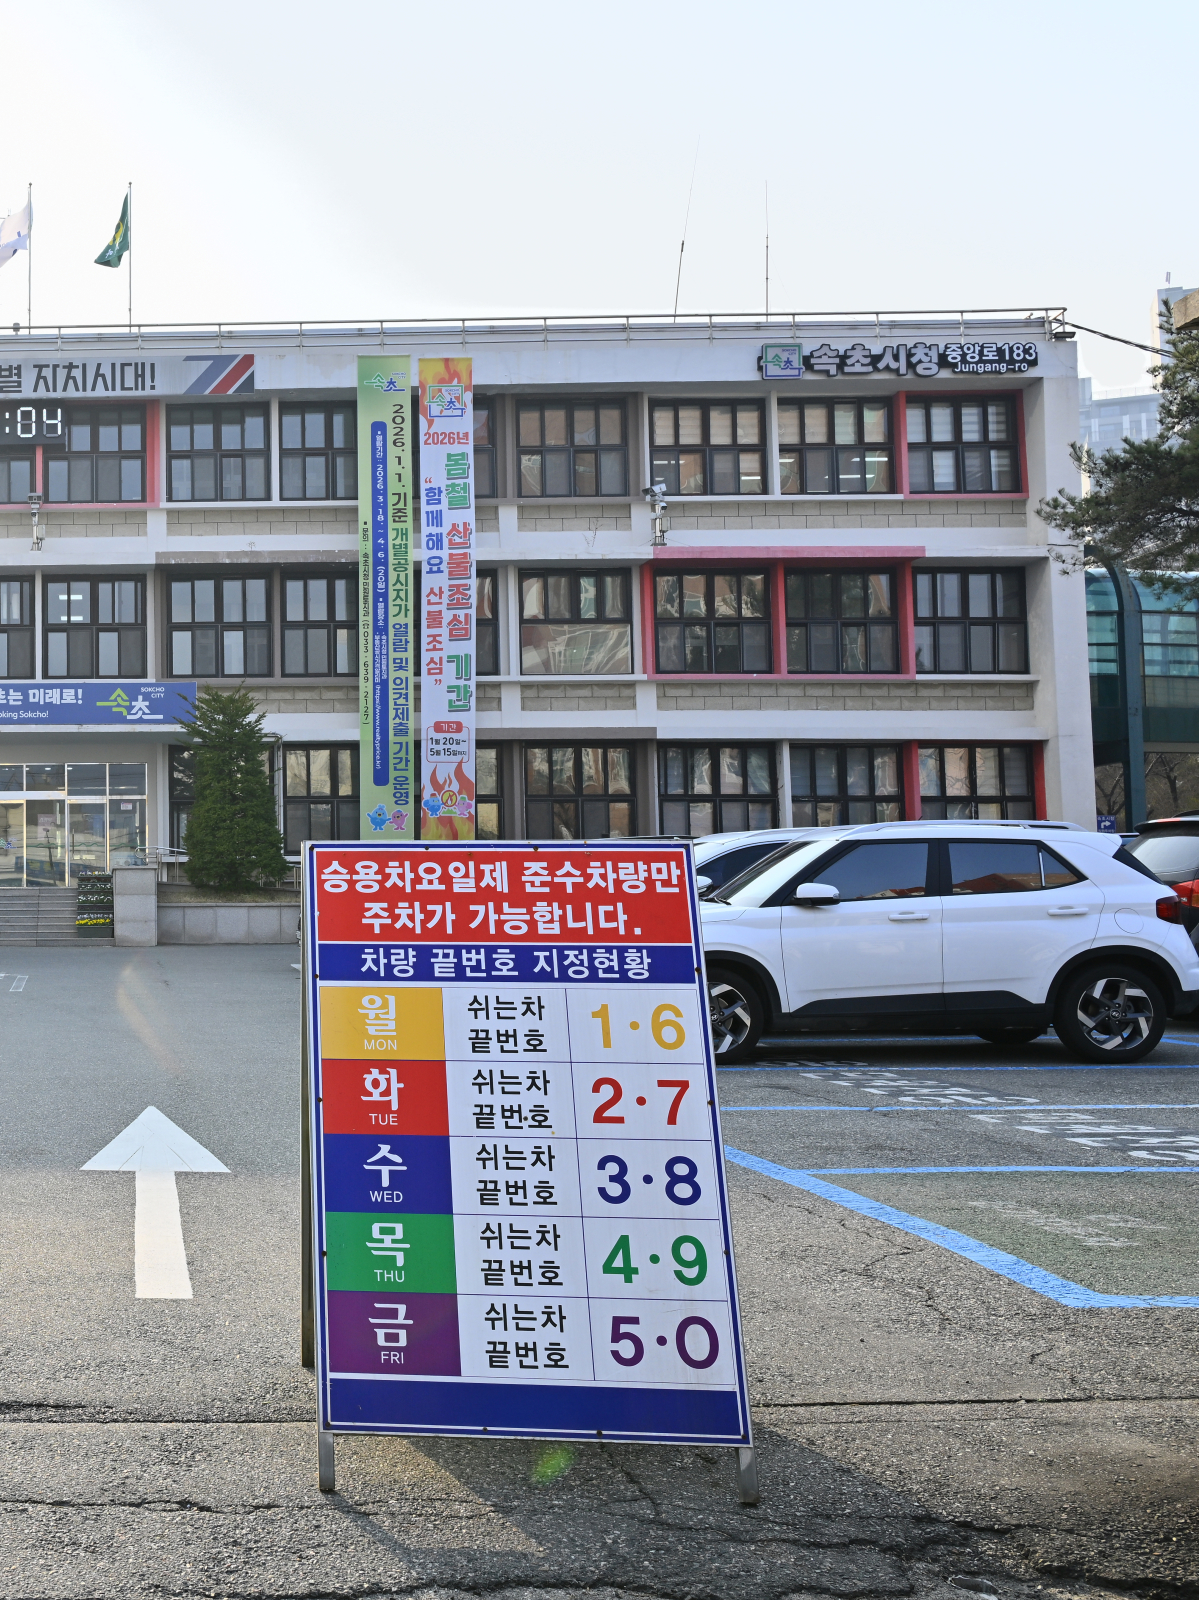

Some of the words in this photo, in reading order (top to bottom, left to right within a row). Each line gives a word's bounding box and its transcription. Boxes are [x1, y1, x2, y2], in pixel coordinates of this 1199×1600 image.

[810, 343, 941, 377] 속초시청
[945, 343, 1037, 362] 중앙로183
[955, 361, 1029, 373] Jungang-ro
[32, 362, 157, 394] 자치시대!
[424, 432, 469, 445] 2026년
[445, 452, 471, 510] 봄철
[392, 492, 408, 523] 기준
[392, 528, 410, 618] 개별공시지가
[446, 522, 472, 640] 산불조심
[392, 622, 410, 653] 열람
[393, 657, 408, 672] 및
[29, 688, 83, 706] 미래로!
[447, 653, 472, 712] 기간
[19, 710, 50, 720] Sokcho!
[392, 677, 410, 737] 의견제출
[440, 723, 457, 732] 기간
[393, 741, 410, 772] 기간
[430, 748, 441, 756] 5월
[393, 775, 410, 806] 운영
[321, 860, 509, 894] 승용차요일제
[521, 860, 681, 894] 준수차량만
[361, 902, 456, 935] 주차가
[469, 901, 642, 936] 가능합니다.
[361, 948, 417, 977] 차량
[430, 948, 519, 978] 끝번호
[533, 949, 652, 980] 지정현황
[358, 994, 397, 1036] 월
[468, 994, 545, 1021] 쉬는차
[364, 1040, 398, 1051] MON
[468, 1029, 548, 1055] 끝번호
[360, 1068, 404, 1112] 화
[472, 1069, 550, 1097] 쉬는차
[369, 1114, 398, 1126] TUE
[472, 1104, 552, 1130] 끝번호
[363, 1144, 407, 1188] 수
[476, 1143, 555, 1172] 쉬는차
[369, 1190, 403, 1203] WED
[476, 1180, 558, 1207] 끝번호
[365, 1222, 410, 1267] 목
[479, 1222, 560, 1252] 쉬는차
[374, 1270, 405, 1283] THU
[480, 1259, 564, 1287] 끝번호
[368, 1303, 413, 1347] 금
[484, 1303, 567, 1333] 쉬는차
[380, 1352, 404, 1365] FRI
[485, 1341, 570, 1370] 끝번호
